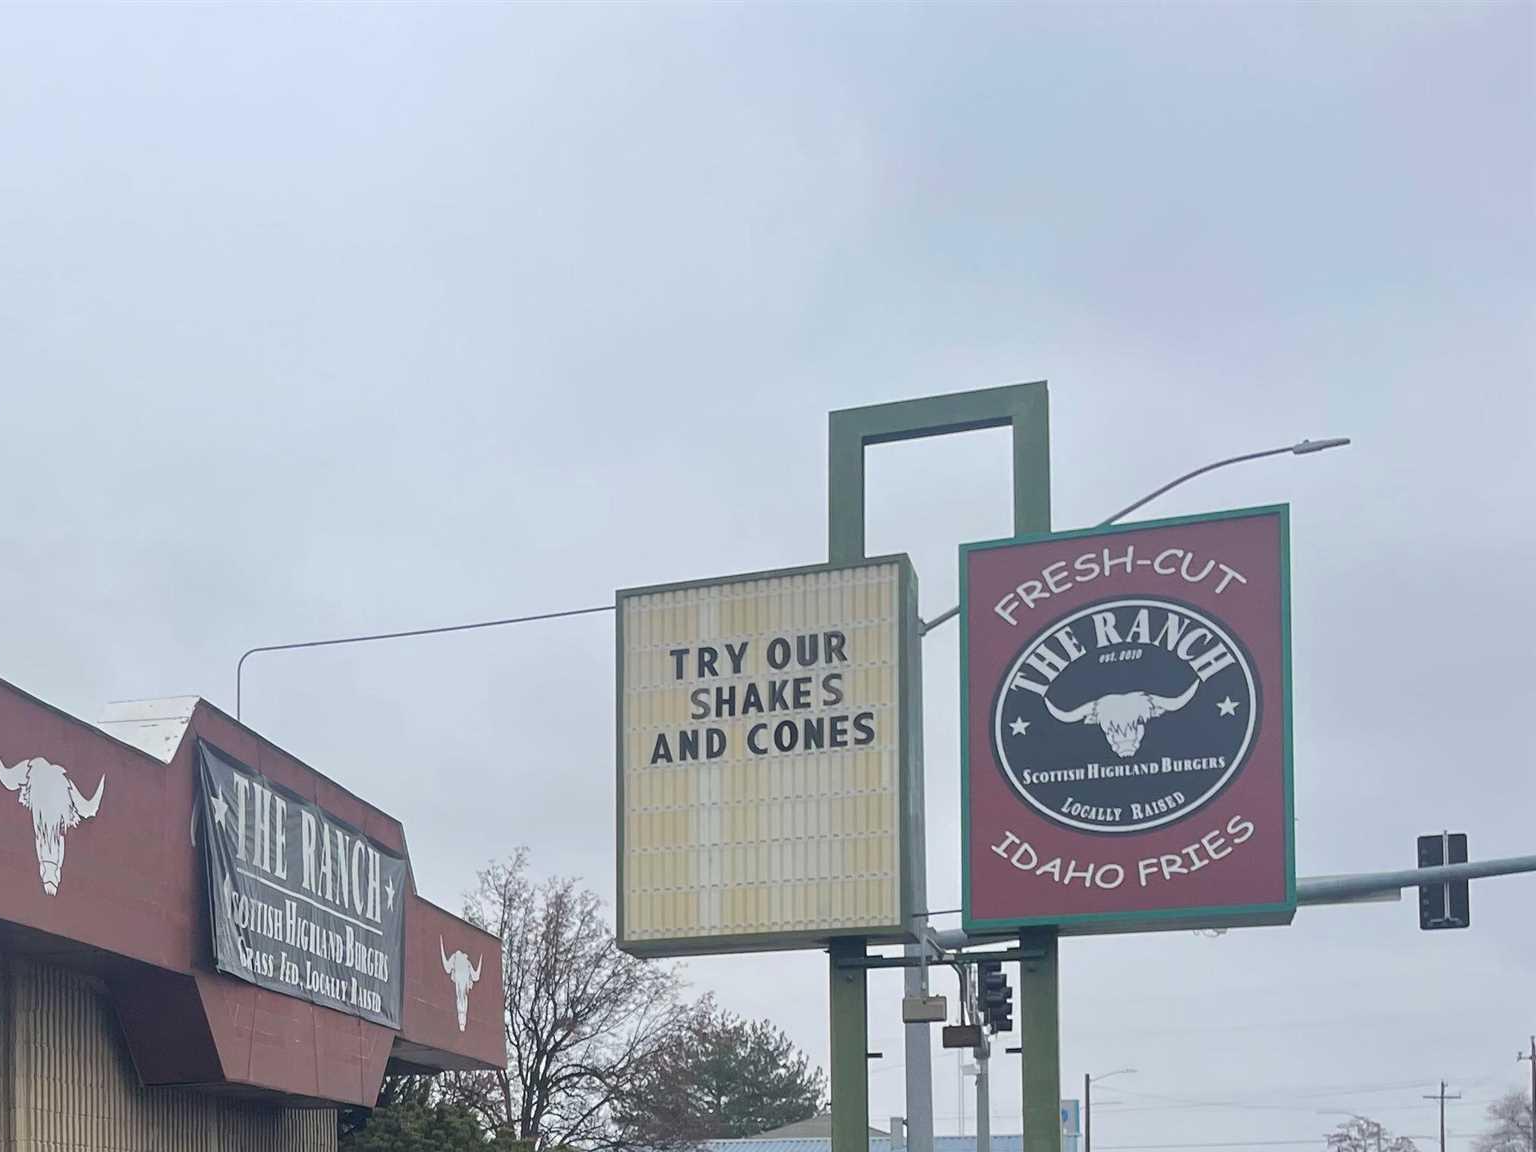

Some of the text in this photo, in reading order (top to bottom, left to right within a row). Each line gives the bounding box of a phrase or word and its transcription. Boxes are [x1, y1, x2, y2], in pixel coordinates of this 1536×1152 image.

[993, 544, 1248, 627] FRESH-CUT
[669, 629, 848, 681] TRY OUR
[1009, 607, 1238, 698] THE RANCH
[690, 672, 844, 720] SHAKES
[650, 711, 876, 765] AND CONES
[1022, 755, 1227, 786] SCOTTISH HIGHLAND BURGERS
[1060, 791, 1186, 822] LOCALLY RAISED
[232, 771, 384, 925] THE RANCH
[991, 814, 1256, 890] IDAHO FRIES
[345, 925, 390, 983] BURGERS
